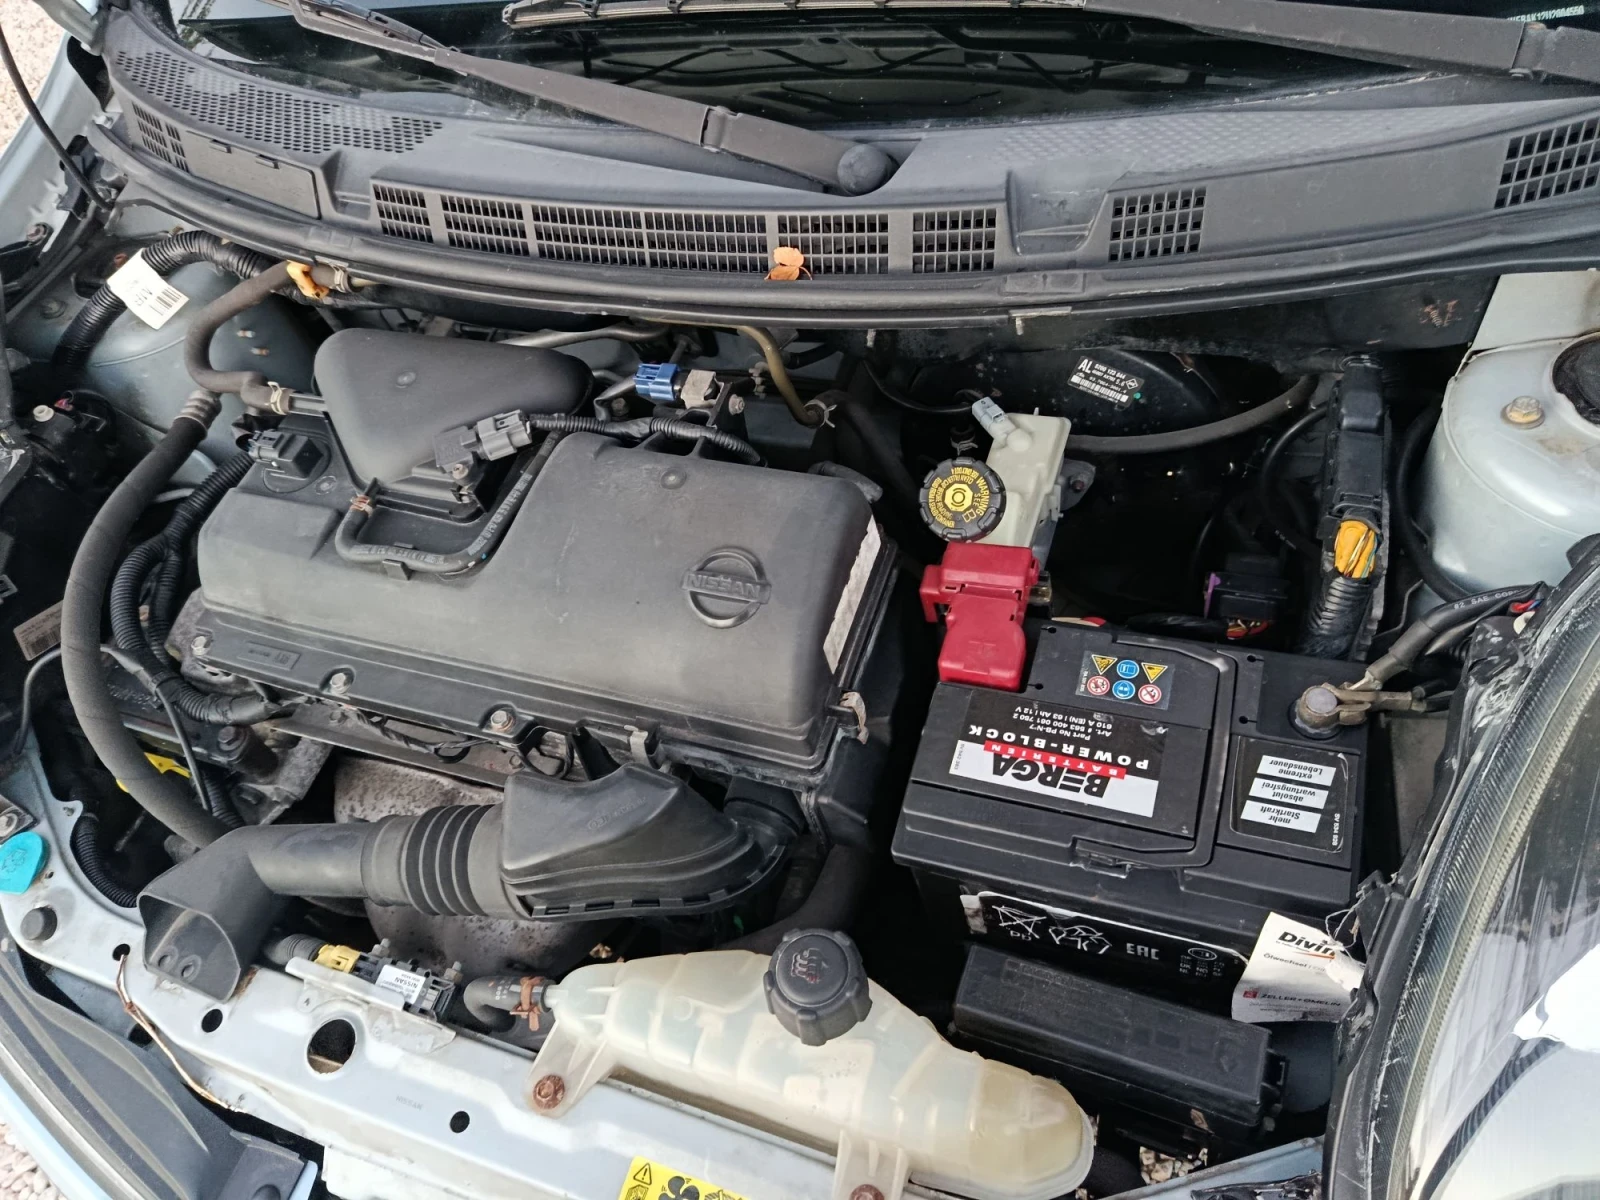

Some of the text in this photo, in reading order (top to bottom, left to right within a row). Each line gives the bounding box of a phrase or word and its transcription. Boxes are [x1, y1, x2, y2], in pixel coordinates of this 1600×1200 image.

[1078, 359, 1092, 373] AL
[976, 477, 989, 516] WARNING
[688, 574, 760, 600] NISSAN
[1471, 596, 1489, 605] SAE
[1069, 716, 1086, 724] (EN)
[1073, 732, 1091, 740] Part
[968, 724, 1149, 770] POWER-BLOCK
[991, 744, 1117, 776] BATTERIEN
[1269, 760, 1323, 775] Lebensdauer
[1279, 769, 1312, 779] extreme
[992, 754, 1112, 798] BERGA
[1262, 782, 1315, 796] wartungsfrei
[1272, 792, 1303, 802] absolut
[1260, 806, 1300, 820] Startkraft
[1268, 816, 1291, 824] mehr
[1126, 943, 1159, 960] EAC
[394, 977, 418, 988] NISSAN
